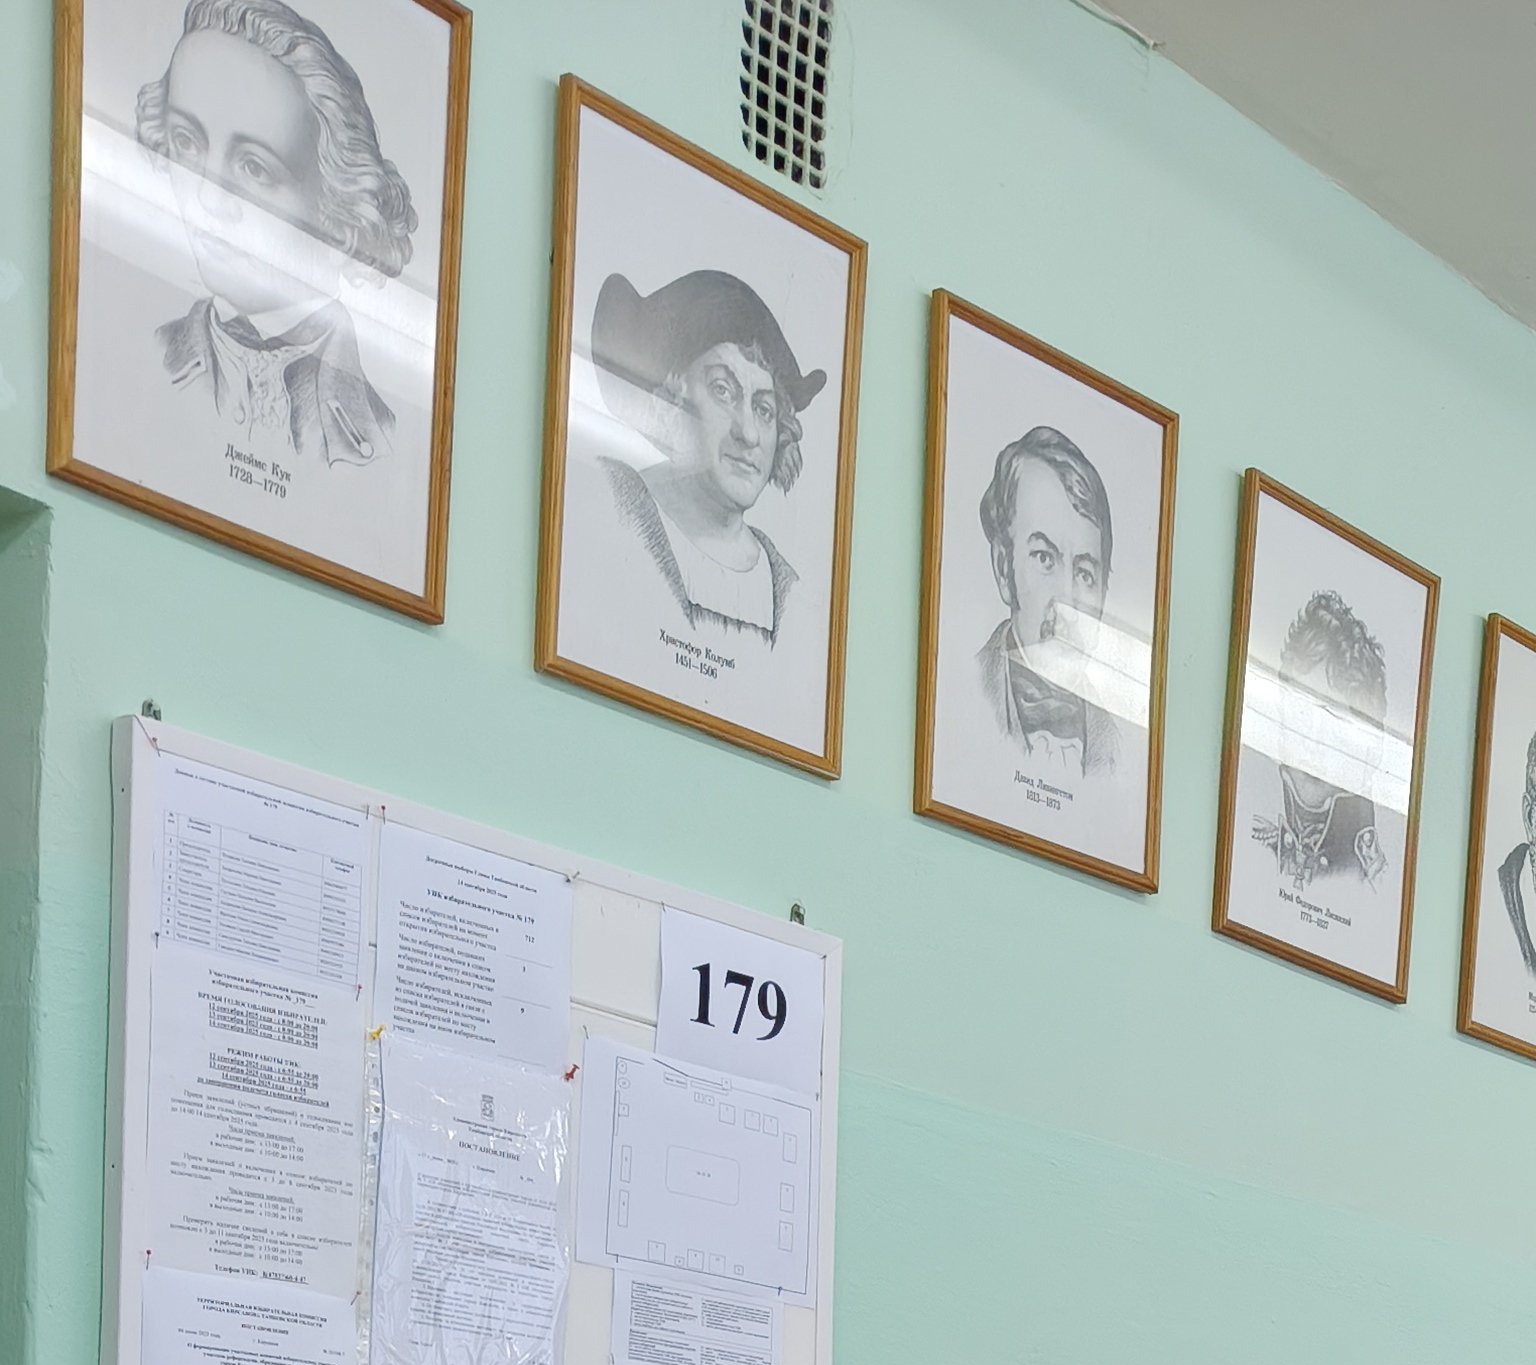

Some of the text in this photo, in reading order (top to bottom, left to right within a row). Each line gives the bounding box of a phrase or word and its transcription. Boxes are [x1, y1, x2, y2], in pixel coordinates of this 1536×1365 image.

[225, 443, 291, 482] Джеймс Кук
[660, 629, 735, 669] Христофор Колумб
[524, 916, 534, 924] 179
[525, 935, 534, 943] 712
[690, 963, 786, 1040] 179
